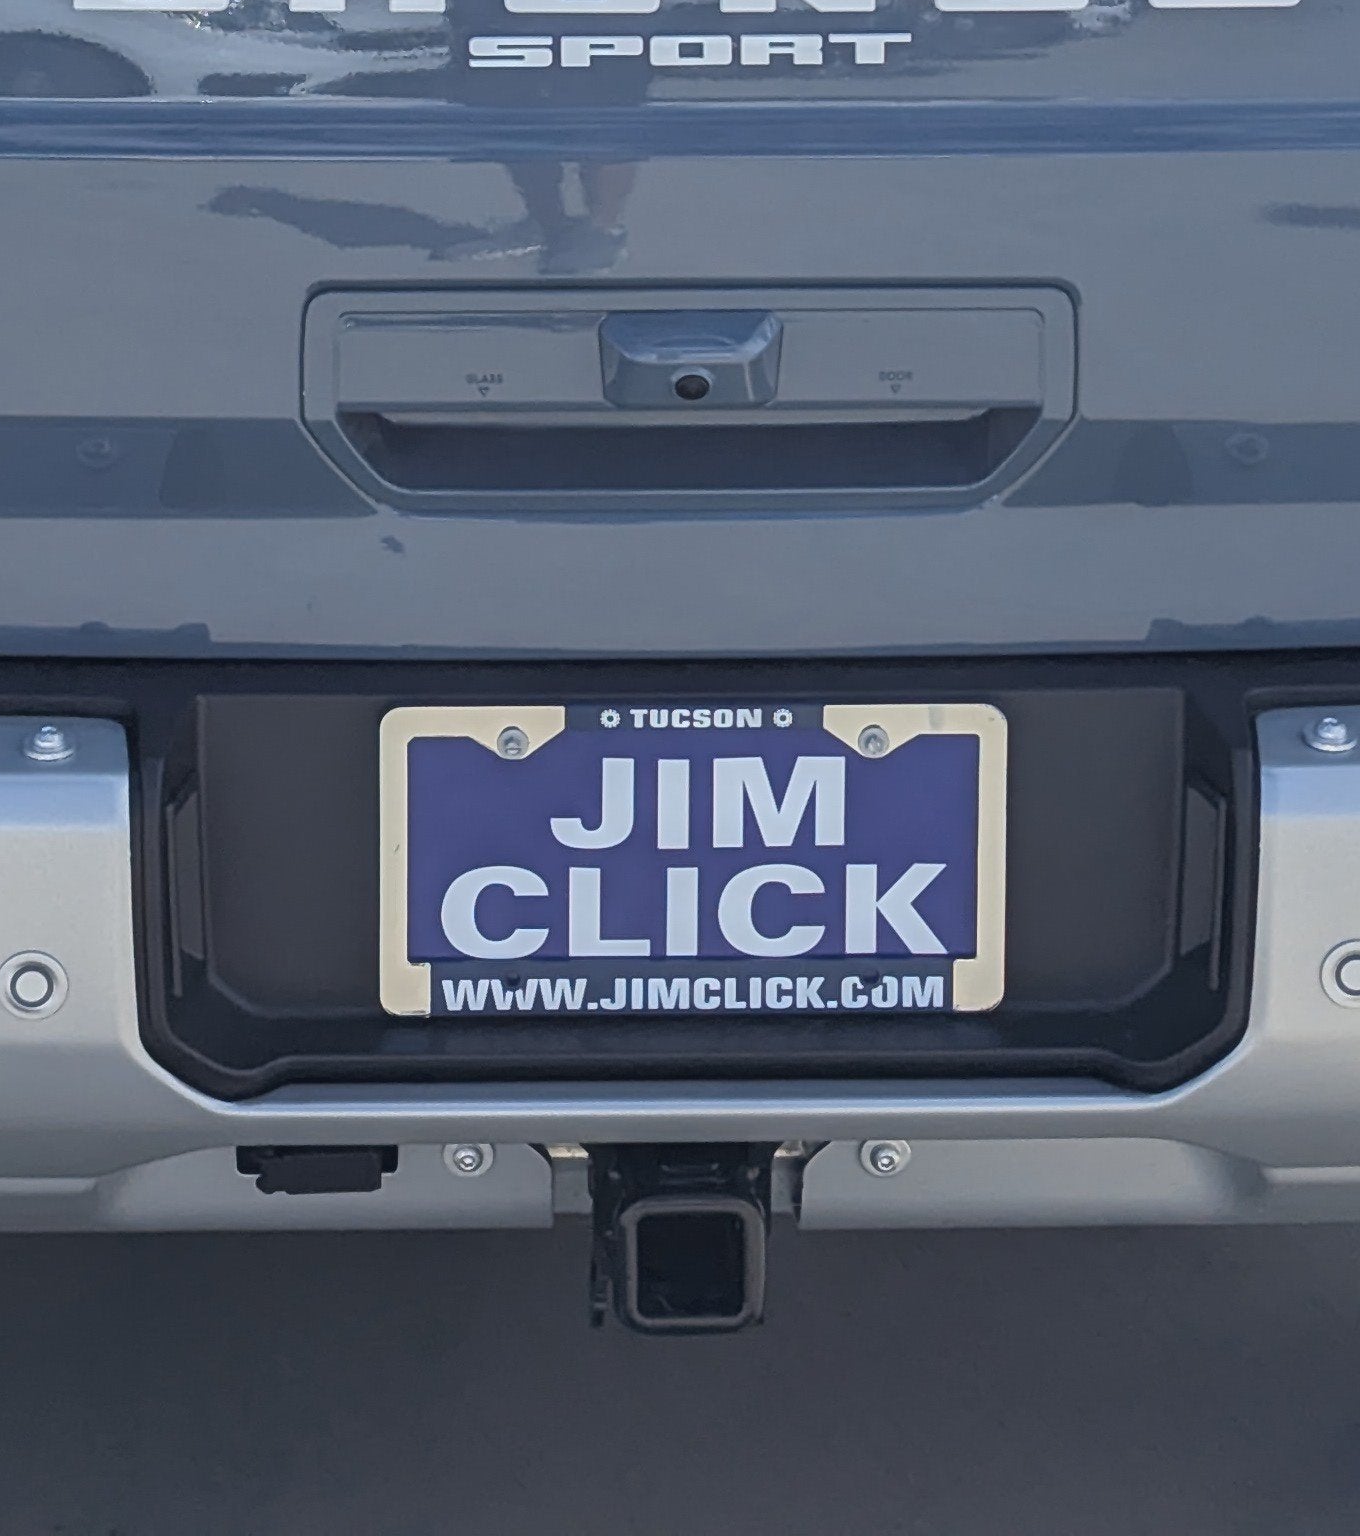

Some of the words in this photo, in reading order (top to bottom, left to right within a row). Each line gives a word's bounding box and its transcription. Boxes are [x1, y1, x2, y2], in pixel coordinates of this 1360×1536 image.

[468, 33, 912, 68] SPORT
[629, 708, 763, 729] TUCSON
[550, 756, 846, 850] JIM
[440, 863, 949, 959] CLICK
[442, 975, 944, 1012] WWW.JIMCLICK.COM
